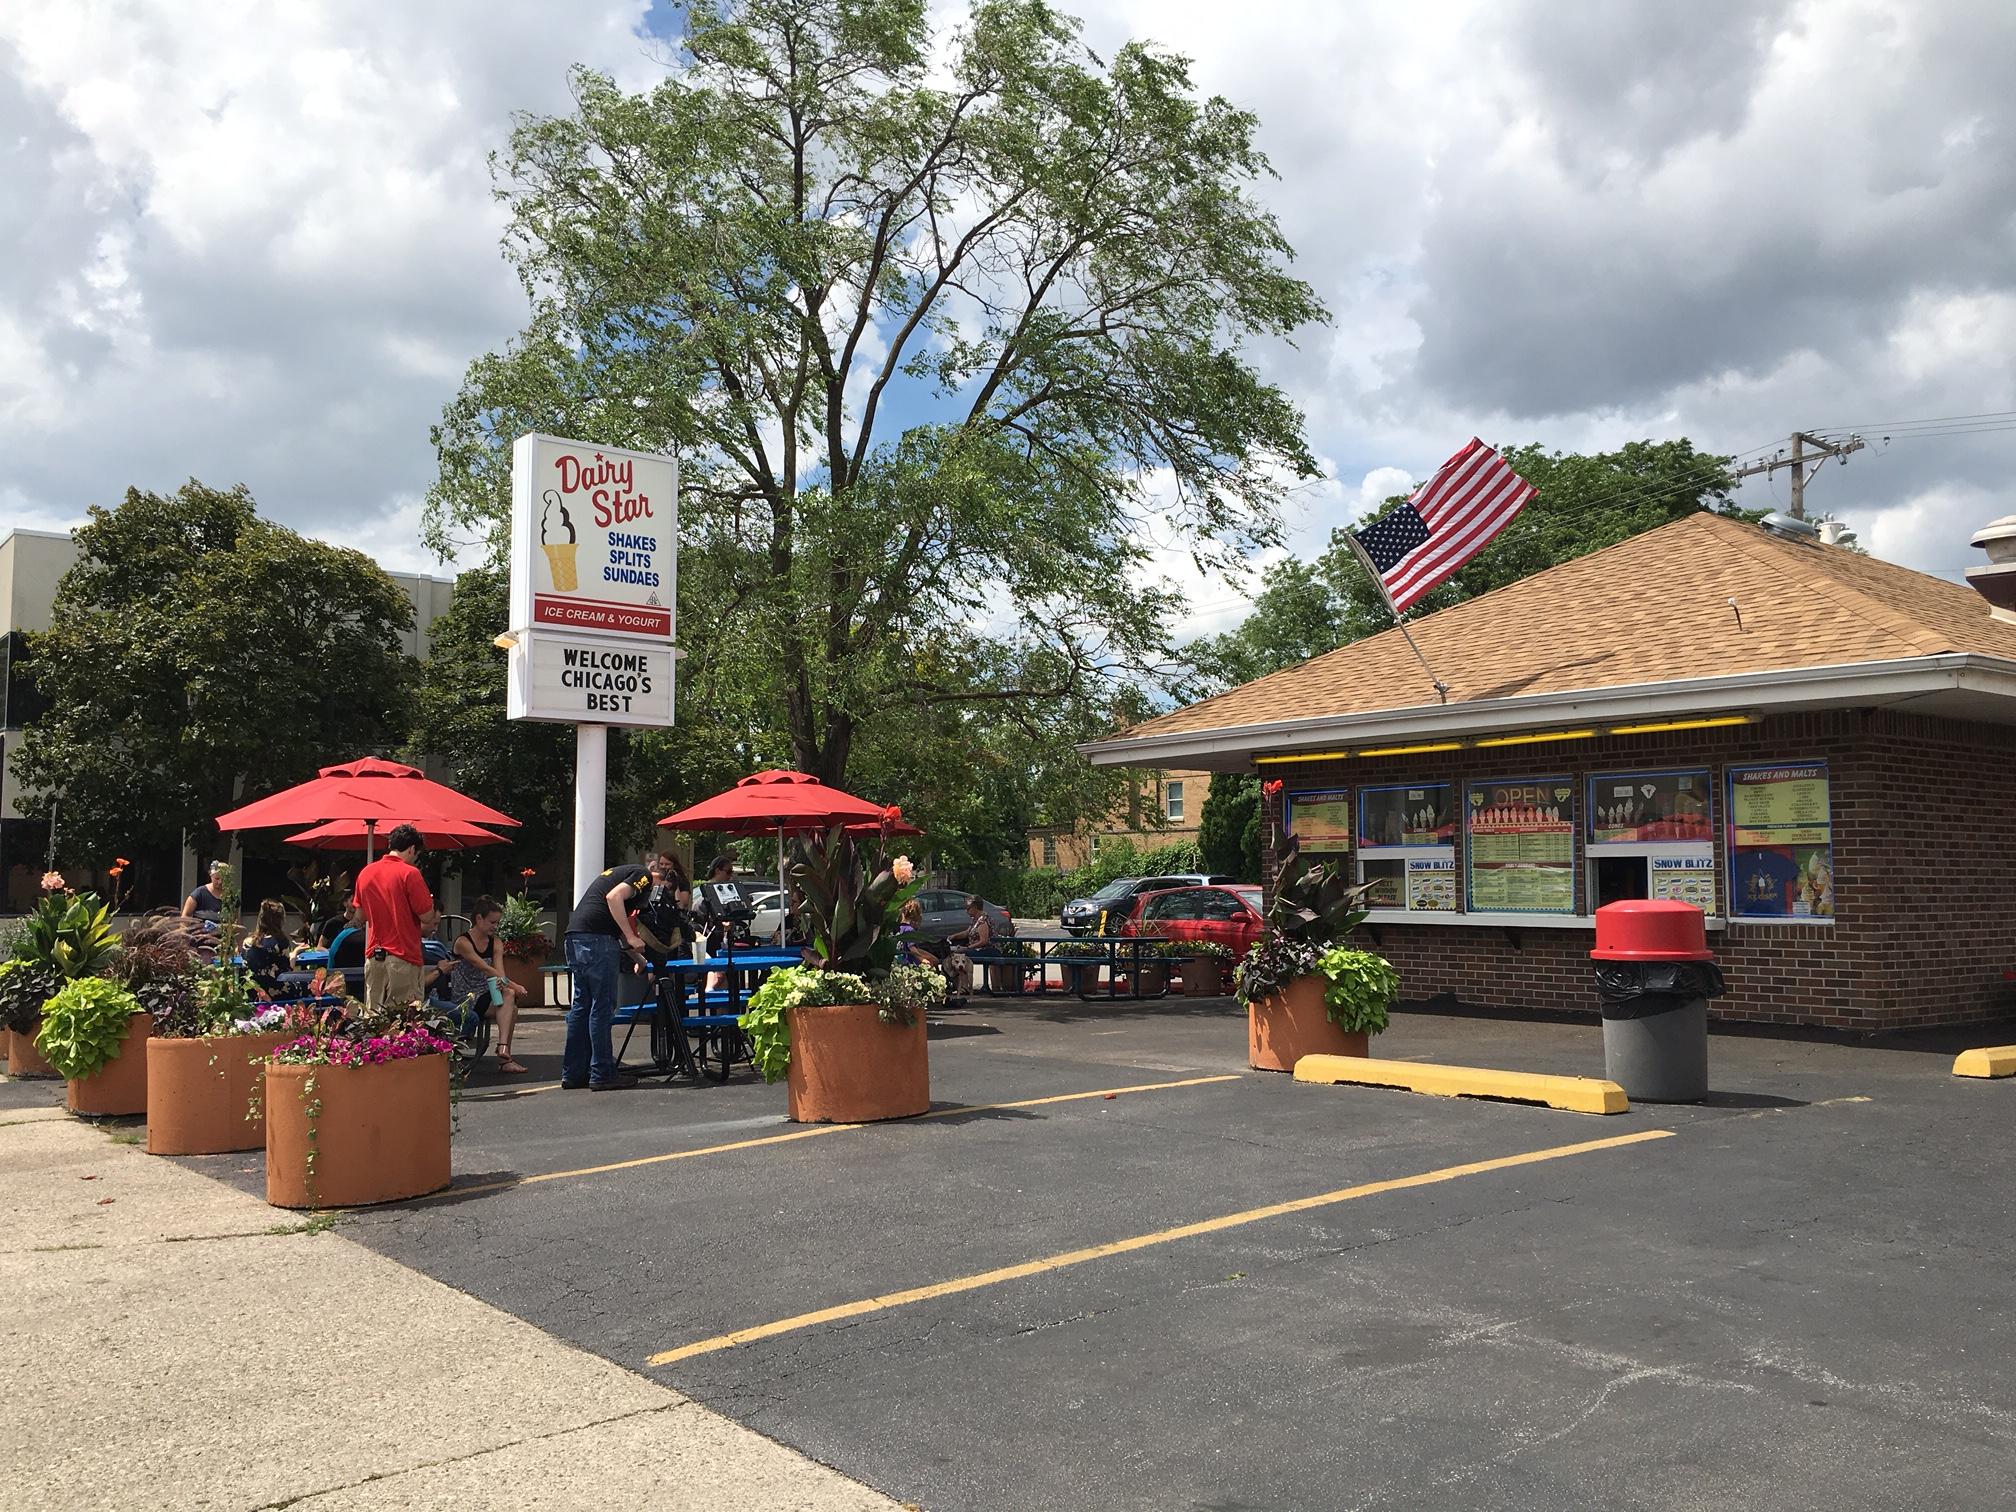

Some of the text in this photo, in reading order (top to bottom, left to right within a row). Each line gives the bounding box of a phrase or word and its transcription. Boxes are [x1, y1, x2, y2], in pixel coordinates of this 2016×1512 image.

[555, 452, 633, 494] Dairy
[592, 490, 653, 528] Star
[608, 531, 657, 552] SHAKES
[609, 549, 651, 569] SPLITS
[603, 566, 660, 587] SUNDAES
[544, 606, 661, 628] ICE CREAM & YOGURT
[563, 648, 648, 673] WELCOME
[561, 670, 651, 694] CHICAGO'S
[587, 692, 633, 712] BEST
[1742, 768, 1818, 781] SHAKES AND MALTS
[1495, 786, 1550, 805] OPEN
[1410, 861, 1455, 870] SNOW BLITZ
[1654, 858, 1713, 869] SNOW BLITZ
